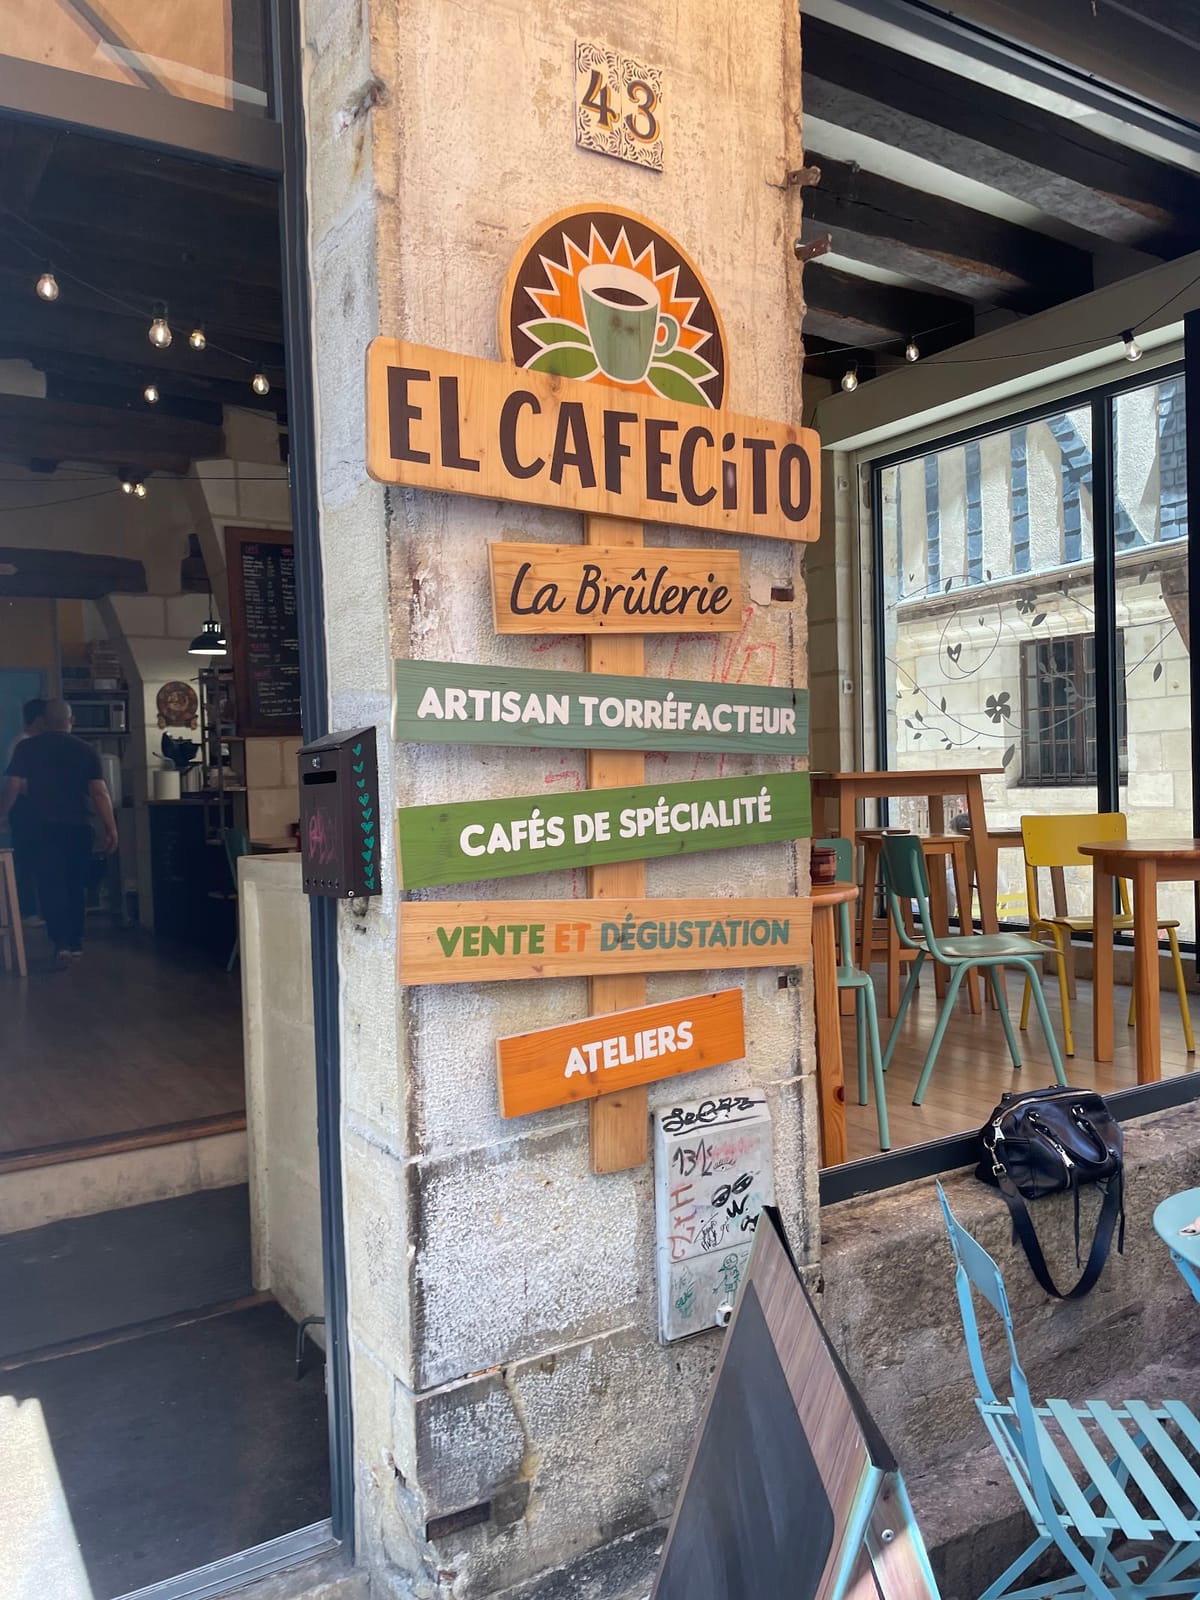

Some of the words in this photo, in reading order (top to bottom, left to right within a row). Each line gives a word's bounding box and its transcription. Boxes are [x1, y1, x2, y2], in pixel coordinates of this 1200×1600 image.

[580, 69, 661, 144] 43
[386, 365, 481, 473] EL
[510, 562, 567, 615] La
[575, 563, 733, 615] Brûlerie
[416, 686, 569, 725] ARTISAN
[579, 691, 797, 736] TORRÉFACTEUR
[459, 808, 566, 857] CAFÉS
[573, 811, 612, 845] DE
[619, 786, 773, 838] SPÉCIALITÉ
[436, 923, 545, 958] VENTE
[554, 922, 592, 953] ET
[600, 913, 790, 953] DÉGUSTATION
[564, 1021, 694, 1079] ATELIERS
